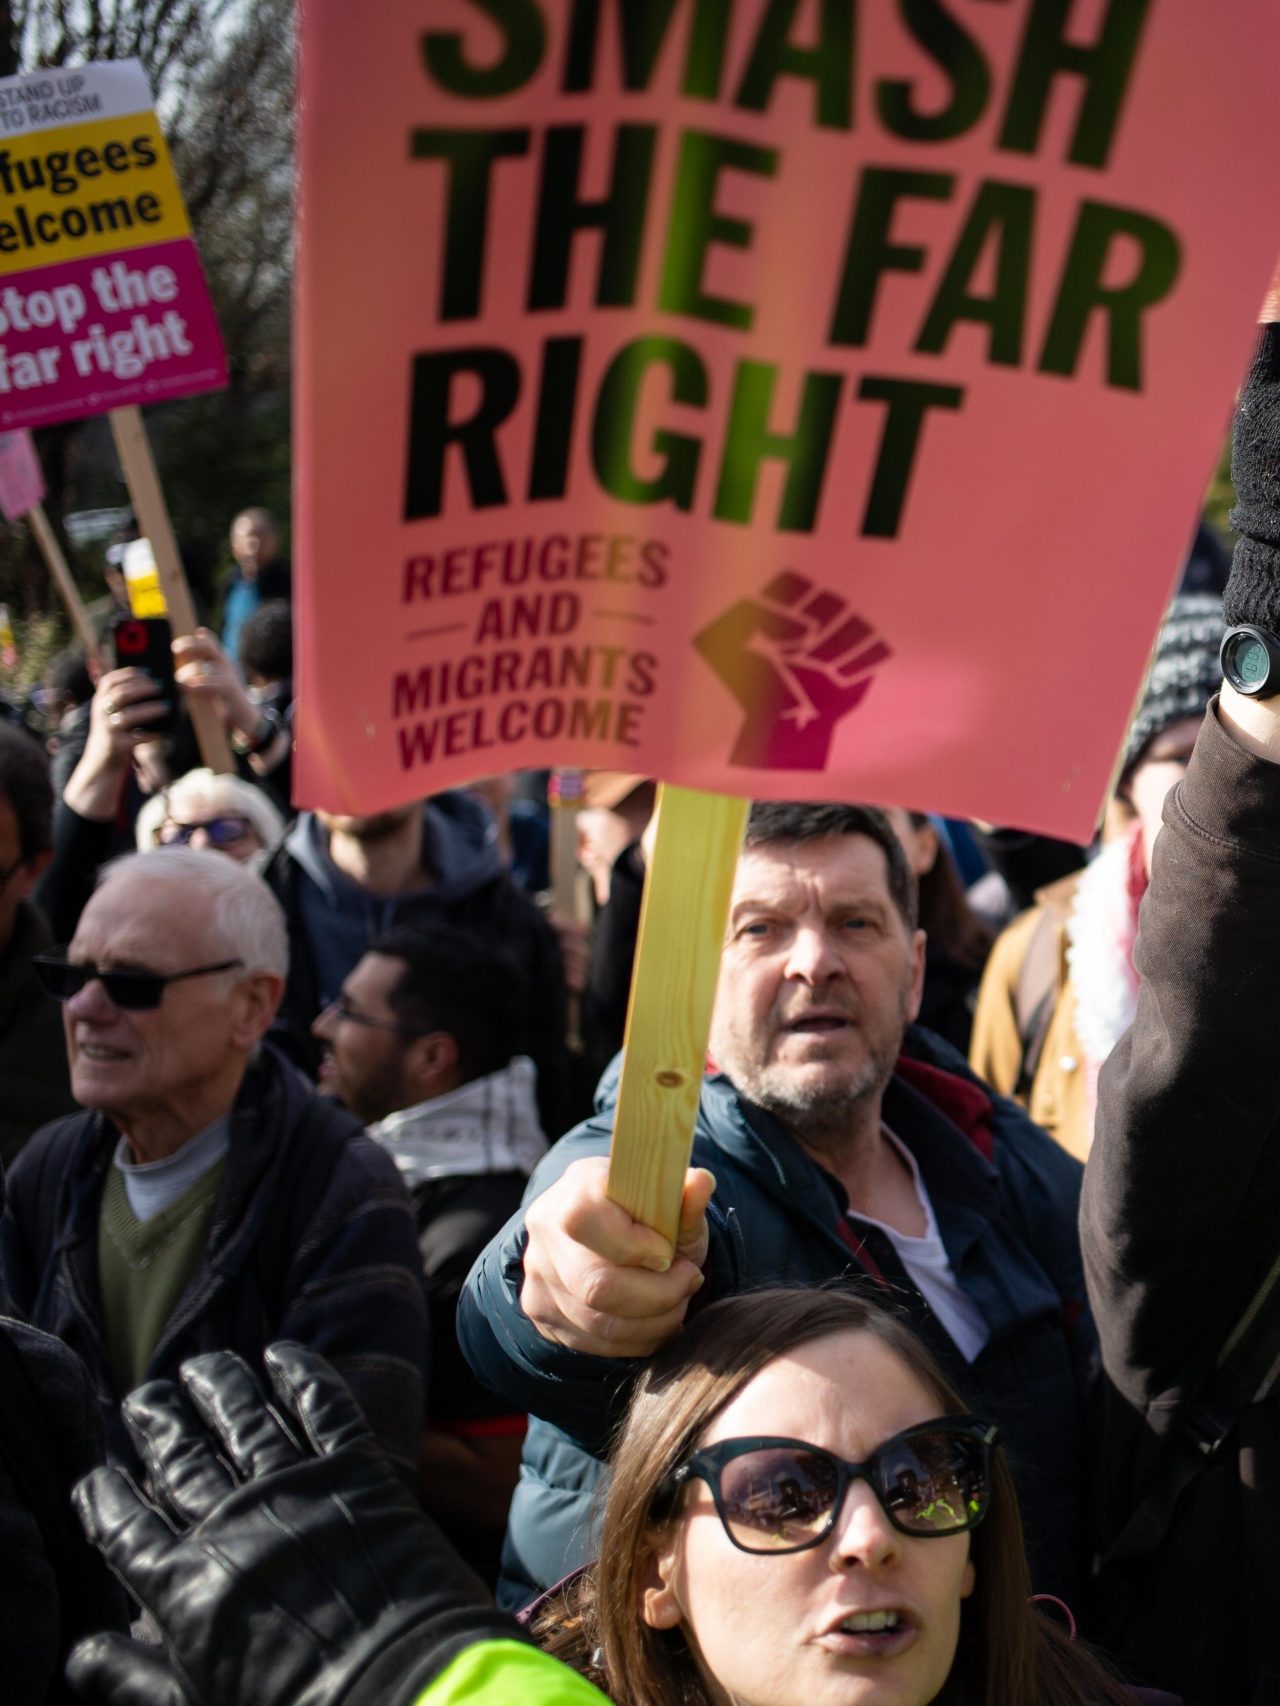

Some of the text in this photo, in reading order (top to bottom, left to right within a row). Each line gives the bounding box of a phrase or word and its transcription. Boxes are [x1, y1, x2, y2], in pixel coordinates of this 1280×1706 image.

[1, 93, 104, 131] TO RACISM
[57, 74, 86, 97] UP
[416, 0, 1151, 171] SMASH
[91, 260, 179, 314] the
[409, 120, 1184, 396] THE FAR
[71, 309, 193, 380] right
[400, 332, 967, 543] RIGHT
[401, 533, 671, 608] REFUGEES
[472, 590, 581, 645] AND
[392, 640, 659, 721] MIGRANTS
[396, 701, 645, 772] WELCOME
